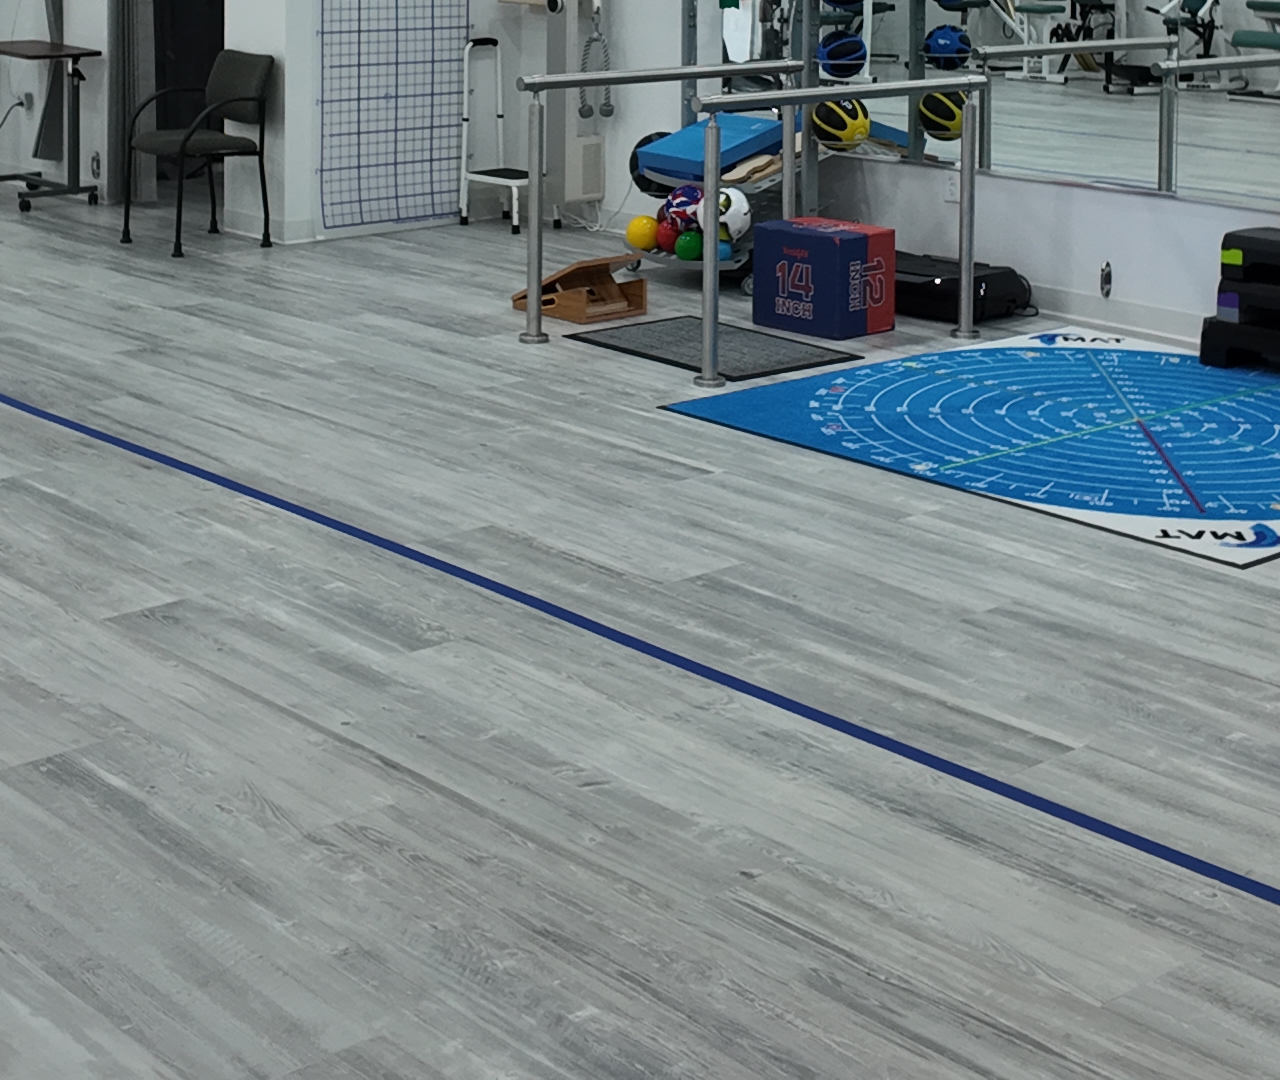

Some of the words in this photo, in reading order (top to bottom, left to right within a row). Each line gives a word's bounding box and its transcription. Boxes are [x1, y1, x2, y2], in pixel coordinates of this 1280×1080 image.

[776, 260, 814, 301] 14
[849, 260, 861, 311] INCH
[861, 257, 885, 309] 12
[775, 296, 814, 320] INCH
[1155, 529, 1246, 541] MAT
